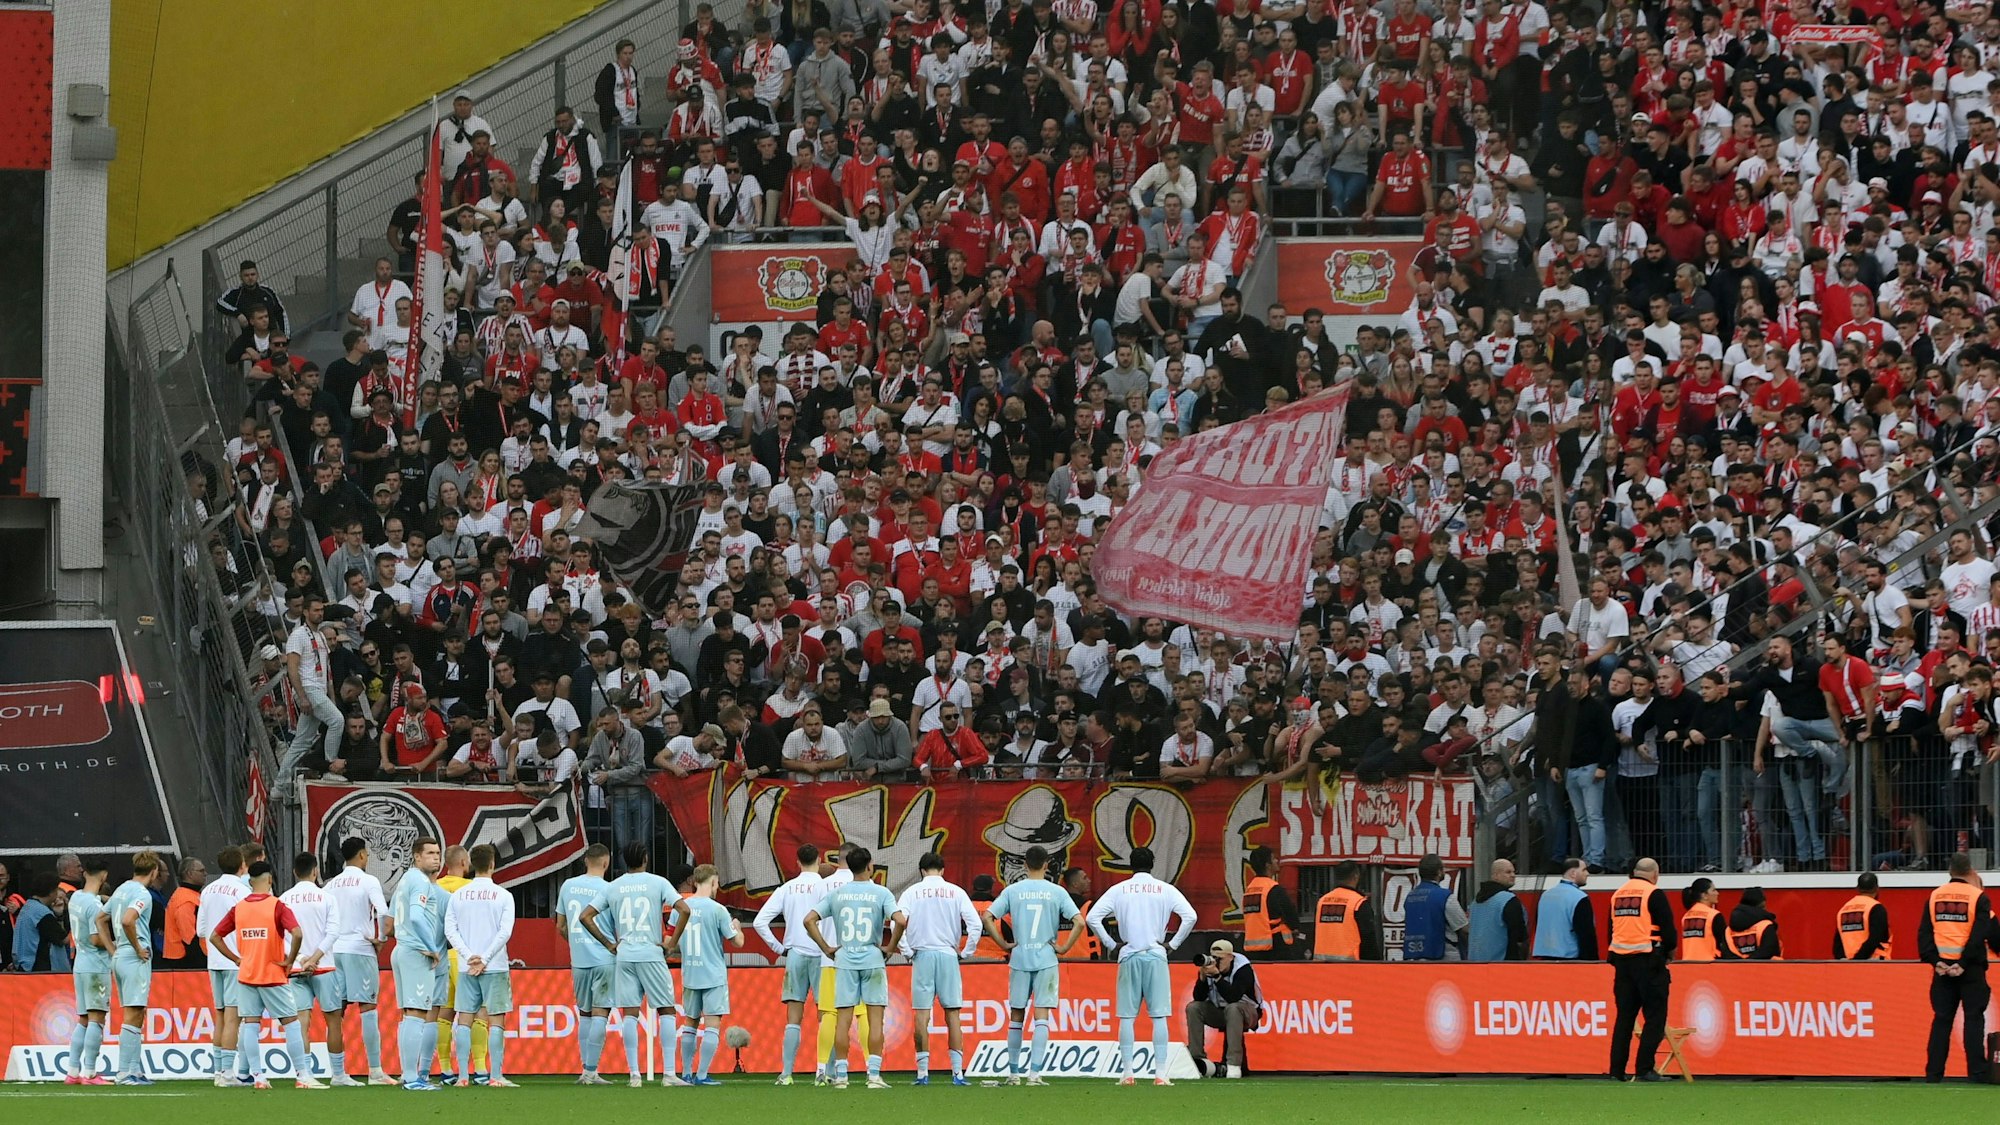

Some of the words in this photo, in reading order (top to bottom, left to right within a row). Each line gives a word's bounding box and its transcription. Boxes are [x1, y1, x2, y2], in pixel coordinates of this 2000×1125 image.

[1183, 103, 1209, 122] REWE
[655, 224, 681, 232] REWE
[1280, 781, 1476, 858] SYNKAT
[465, 891, 475, 900] FC
[477, 888, 497, 901] KÖLN
[570, 886, 598, 897] CHABOT
[619, 883, 648, 894] DOWNS
[796, 884, 805, 894] FC
[922, 888, 932, 898] FC
[935, 886, 954, 899] KÖLN
[1130, 883, 1139, 893] FC
[1142, 883, 1162, 894] KÖLN
[291, 894, 300, 904] FC
[302, 892, 322, 903] KÖLN
[619, 896, 650, 932] 42
[1026, 904, 1044, 940] 7
[840, 906, 872, 943] 35
[241, 929, 267, 939] REWE
[685, 921, 701, 957] 11
[1246, 999, 1353, 1035] DVANCE
[1473, 1000, 1608, 1036] LEDVANCE
[1734, 1000, 1875, 1038] LEDVANCE
